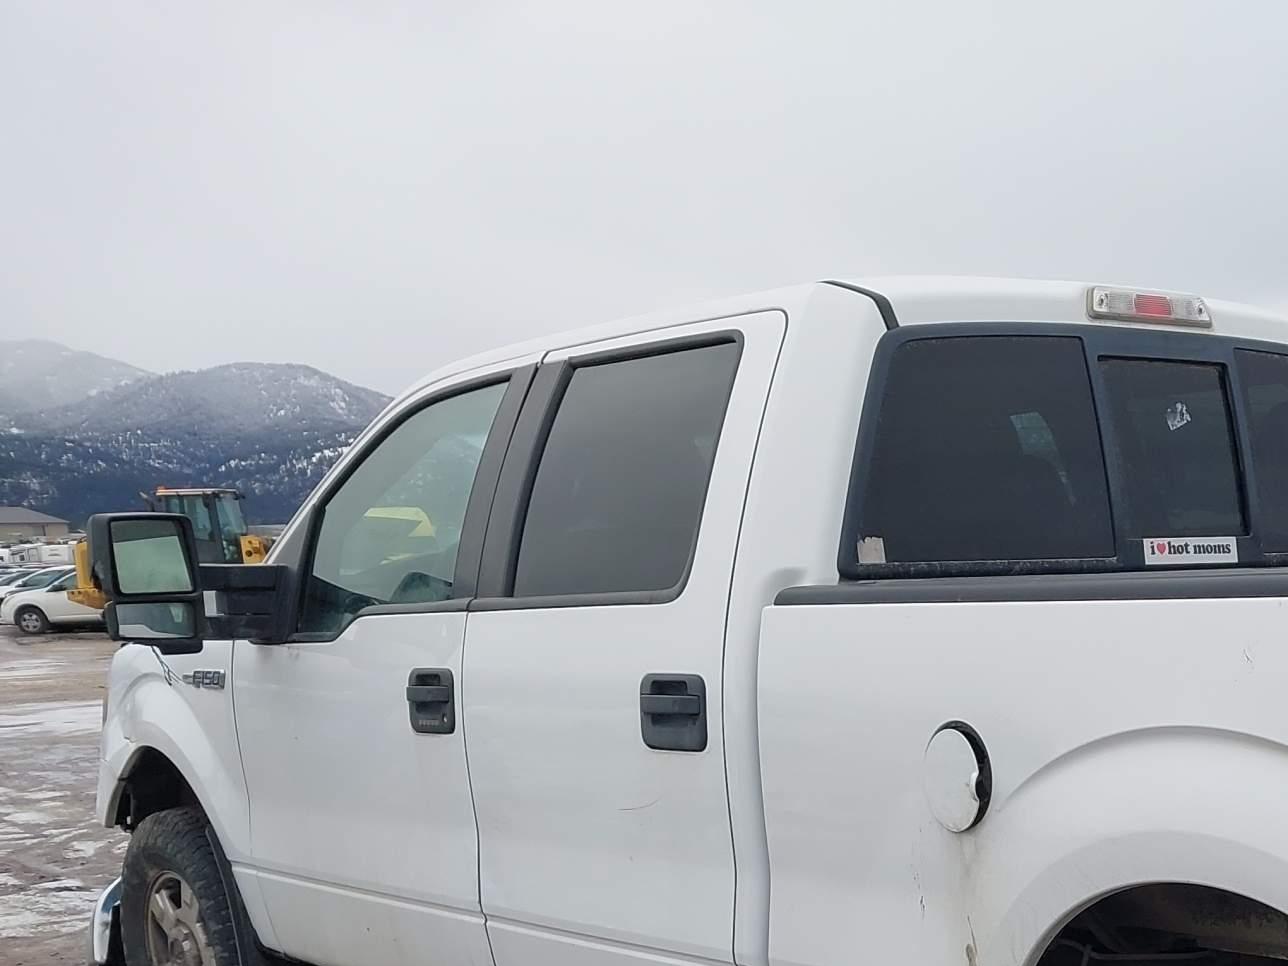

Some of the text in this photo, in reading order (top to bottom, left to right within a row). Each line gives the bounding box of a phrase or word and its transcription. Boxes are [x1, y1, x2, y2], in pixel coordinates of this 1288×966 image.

[1150, 541, 1232, 555] i hot moms
